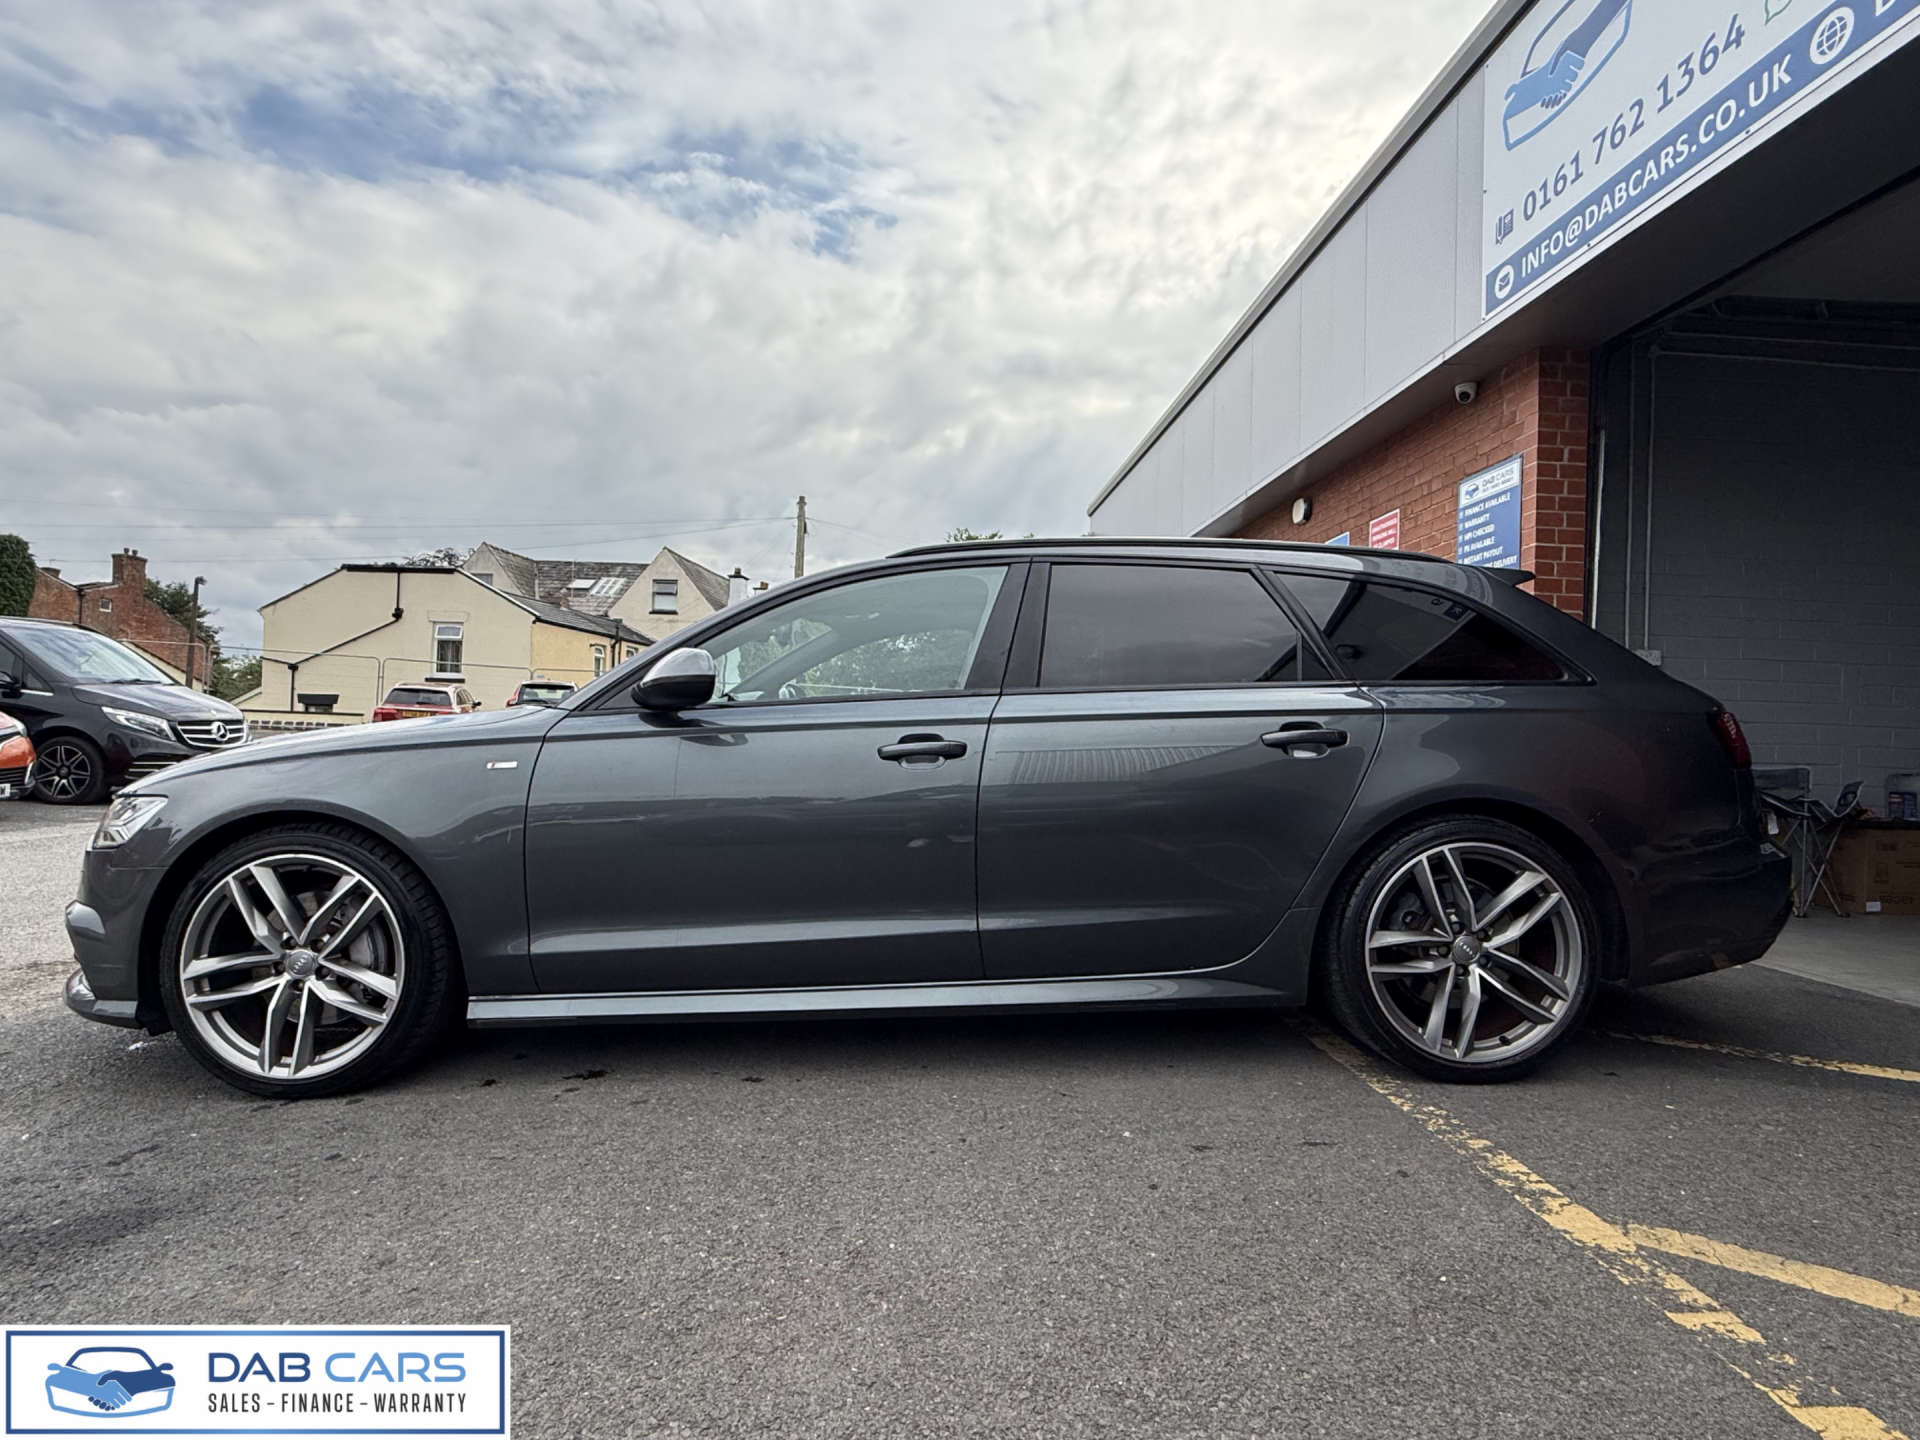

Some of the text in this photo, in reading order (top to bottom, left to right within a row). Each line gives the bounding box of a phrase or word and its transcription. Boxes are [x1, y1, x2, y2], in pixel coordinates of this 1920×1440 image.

[1521, 53, 1792, 278] INFO@DABCARS.CO.UK
[1523, 13, 1745, 221] 0161 762 1364
[1464, 502, 1484, 516] FINANCE
